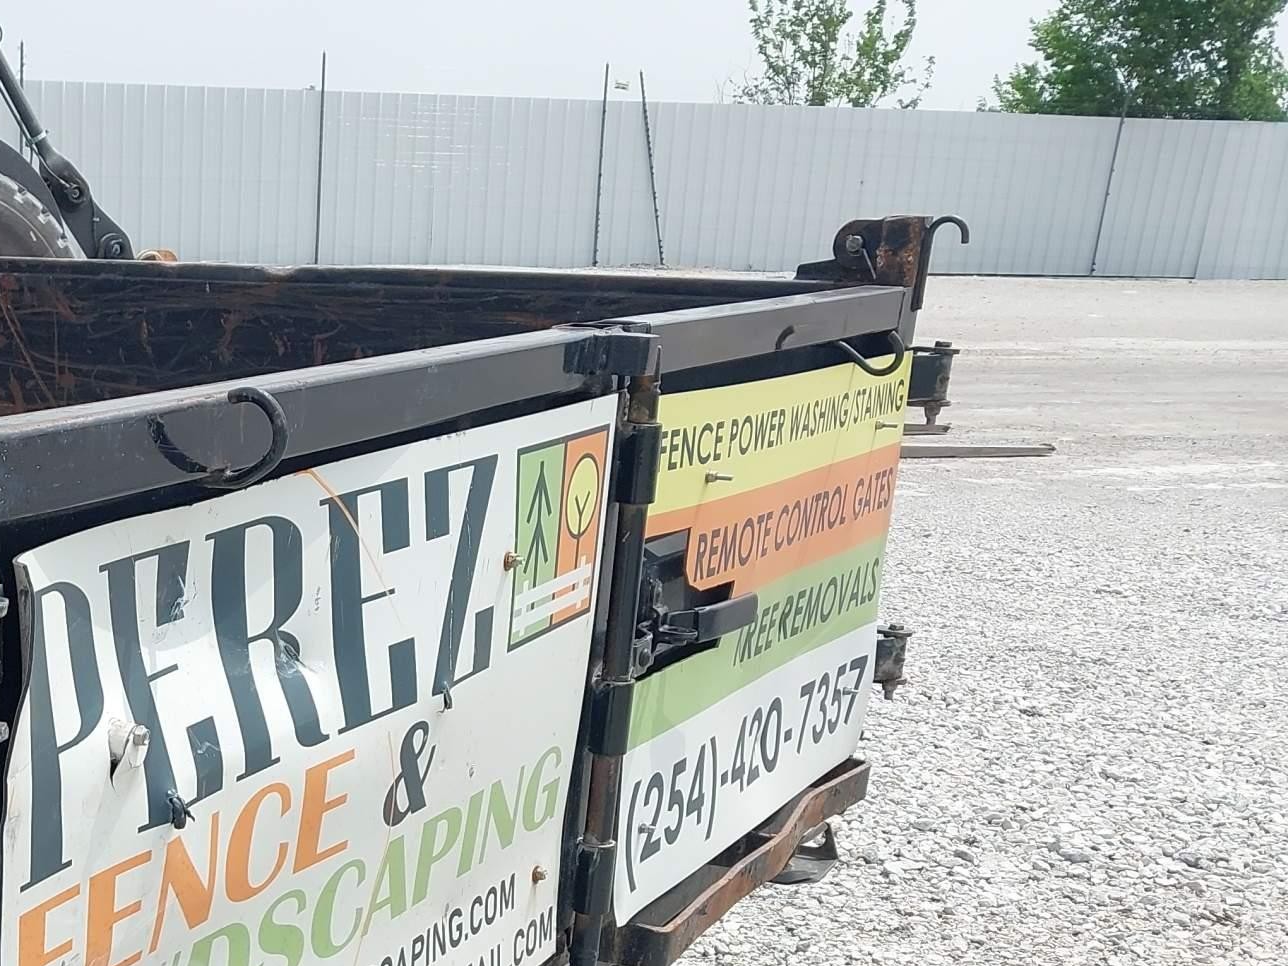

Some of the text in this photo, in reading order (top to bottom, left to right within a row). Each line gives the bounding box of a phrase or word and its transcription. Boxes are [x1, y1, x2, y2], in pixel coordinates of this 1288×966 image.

[658, 378, 905, 472] FENCE POWER WASHING/STAINING
[693, 467, 893, 582] REMOTE CONTROL GATES
[778, 558, 880, 642] REMOVALS
[20, 453, 499, 892] PEREZ
[383, 719, 437, 827] &
[625, 655, 869, 893] (254)-420-7357
